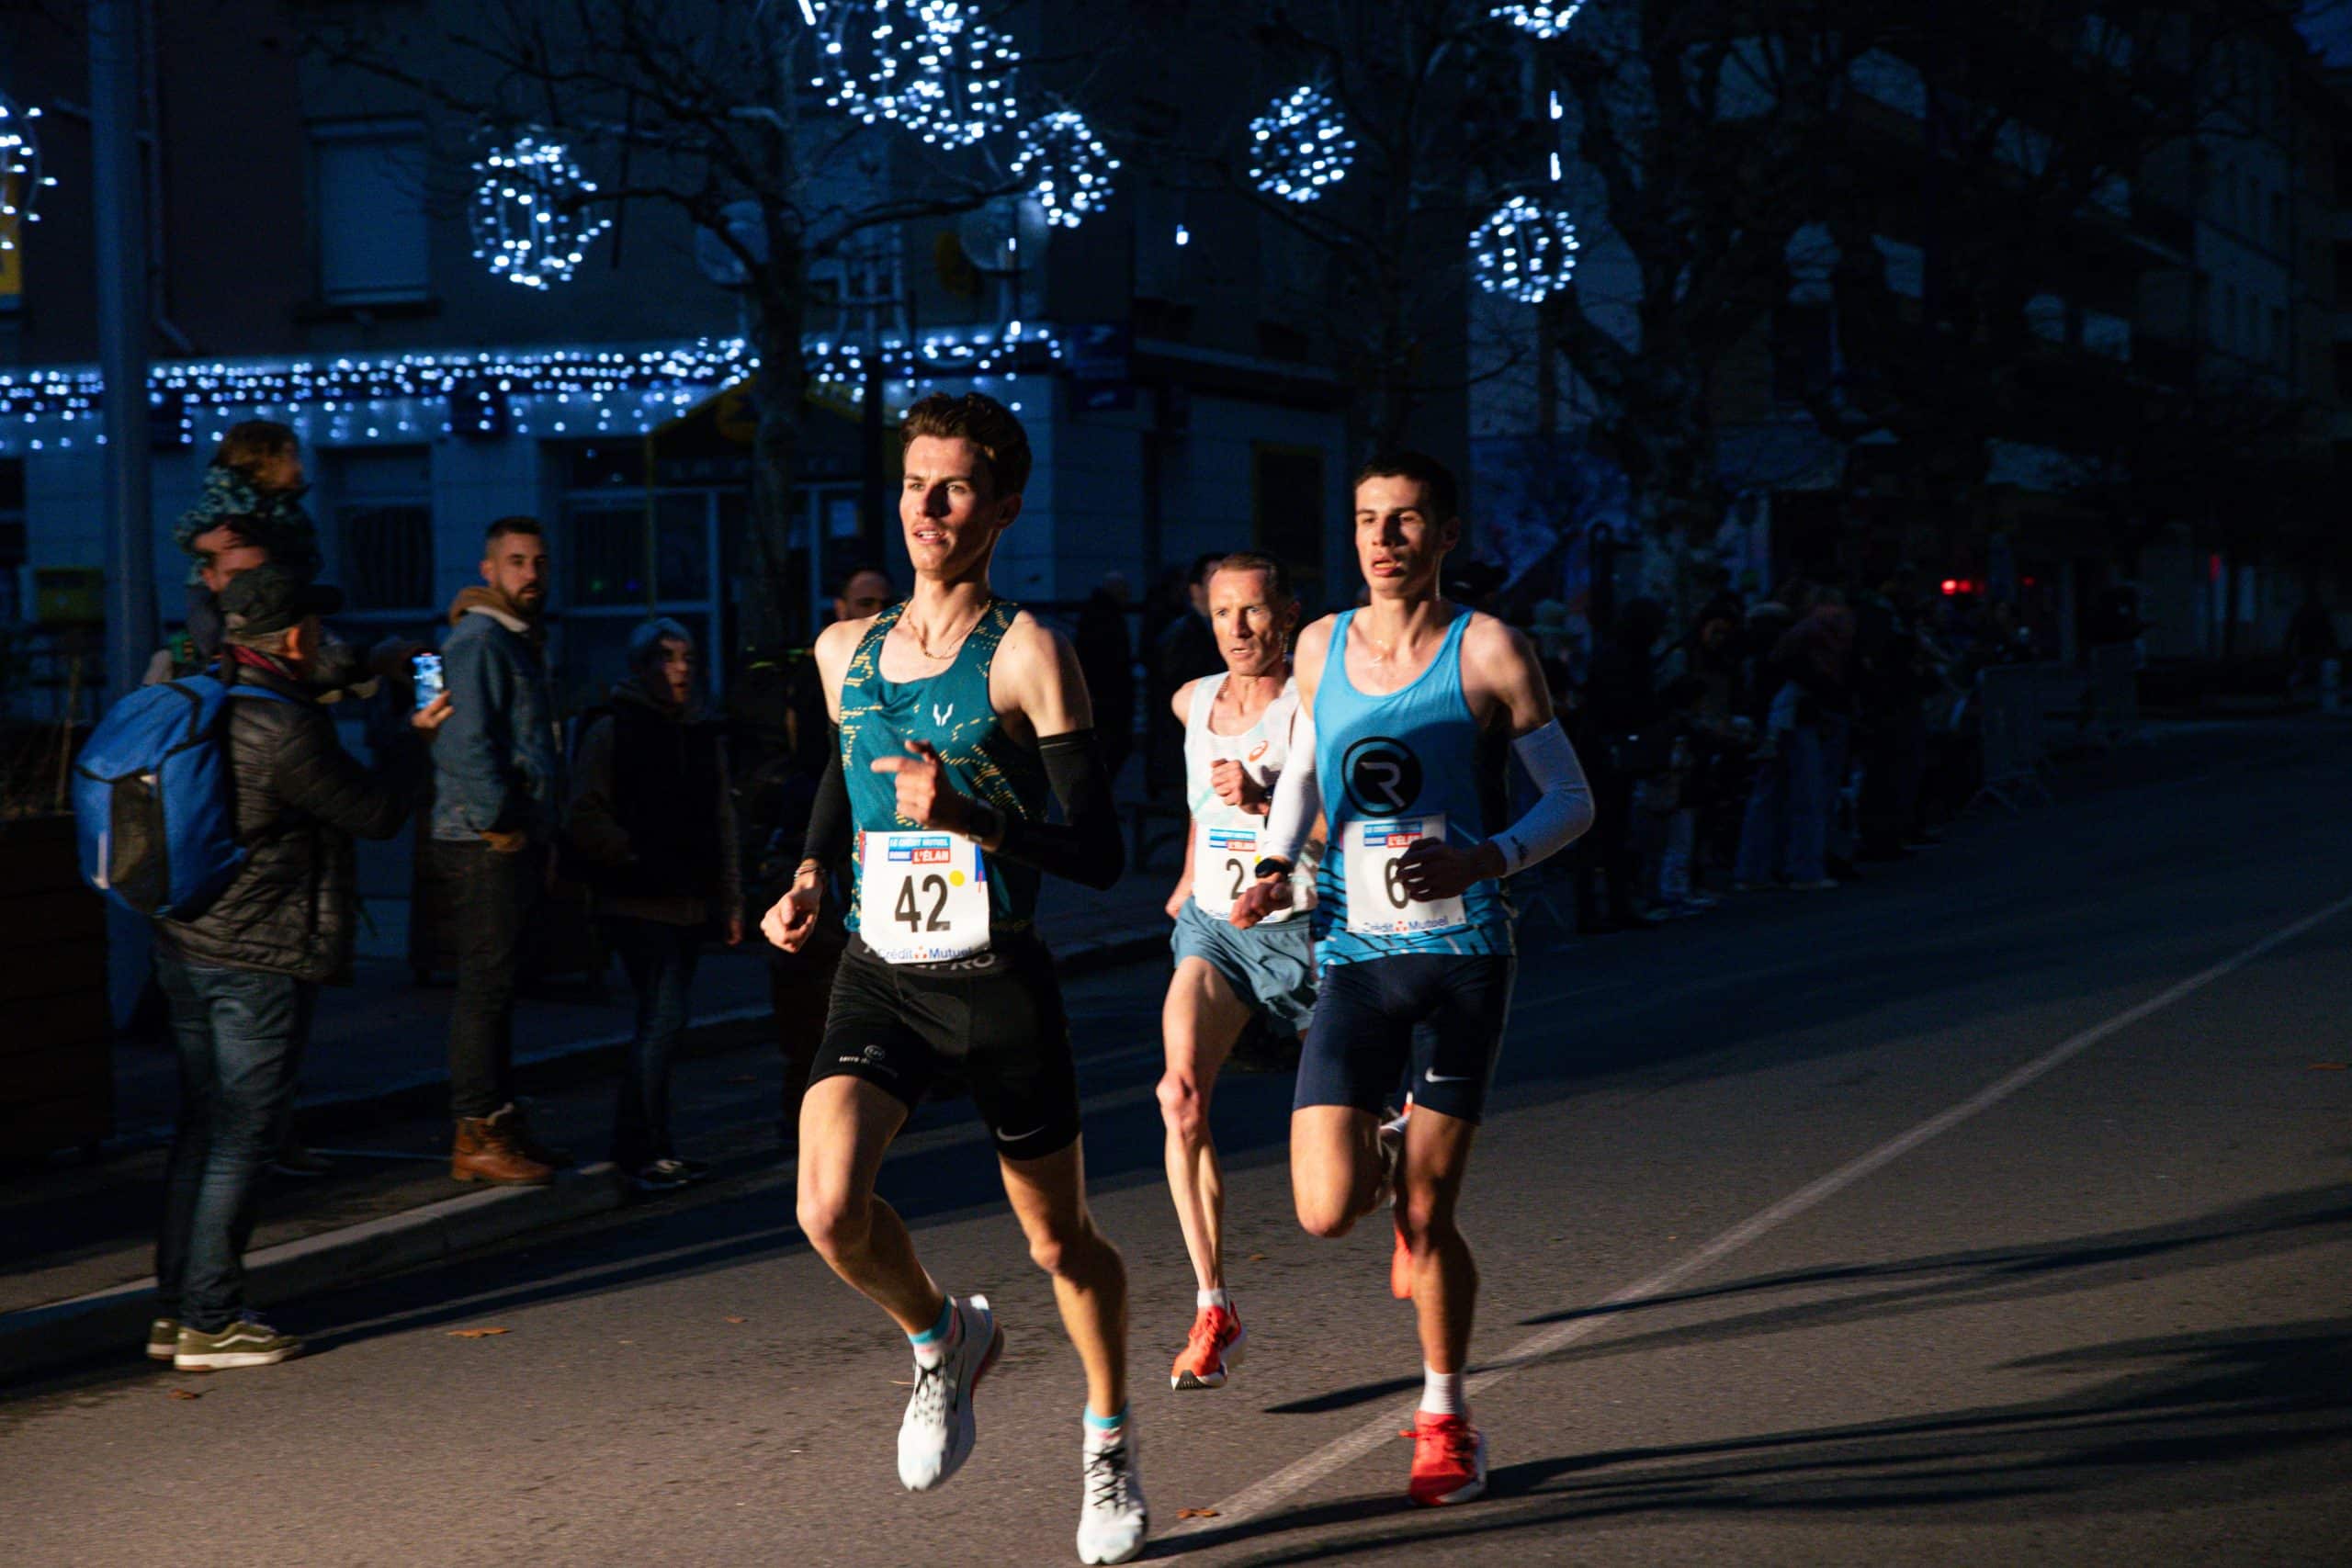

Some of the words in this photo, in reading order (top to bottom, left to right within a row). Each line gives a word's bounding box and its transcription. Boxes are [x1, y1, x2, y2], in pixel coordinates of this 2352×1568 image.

[894, 874, 951, 933] 42
[1227, 858, 1245, 900] 2
[1385, 857, 1409, 908] 6
